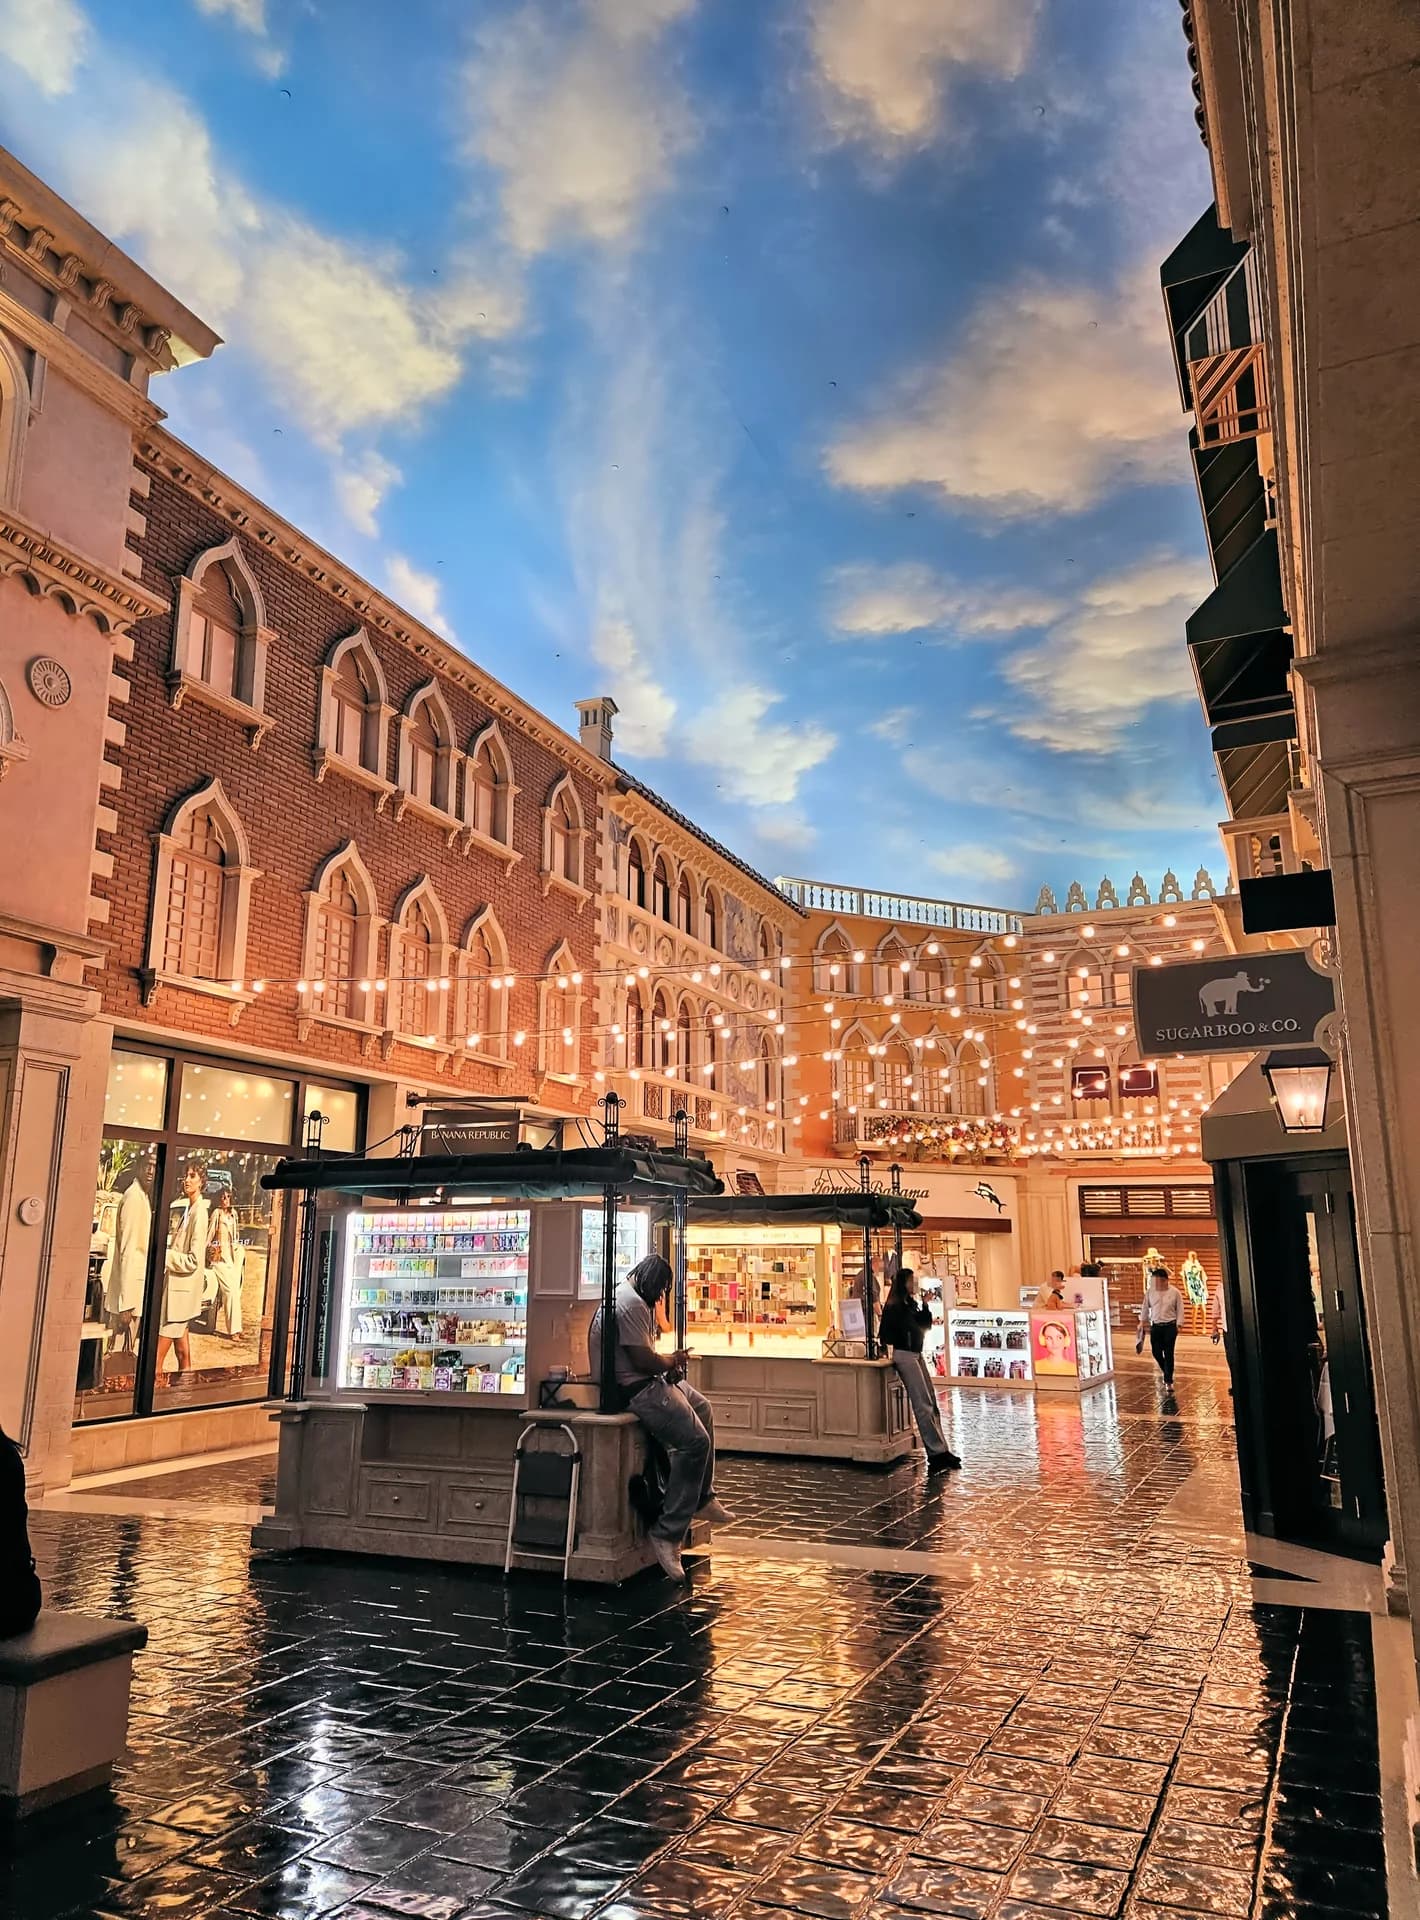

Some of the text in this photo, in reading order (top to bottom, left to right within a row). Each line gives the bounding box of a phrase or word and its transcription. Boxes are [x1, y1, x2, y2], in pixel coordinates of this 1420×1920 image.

[1155, 1018, 1302, 1041] SUGARBOO & CO.
[468, 1130, 511, 1140] REPUBLIC
[811, 1178, 930, 1198] Tomm Baama
